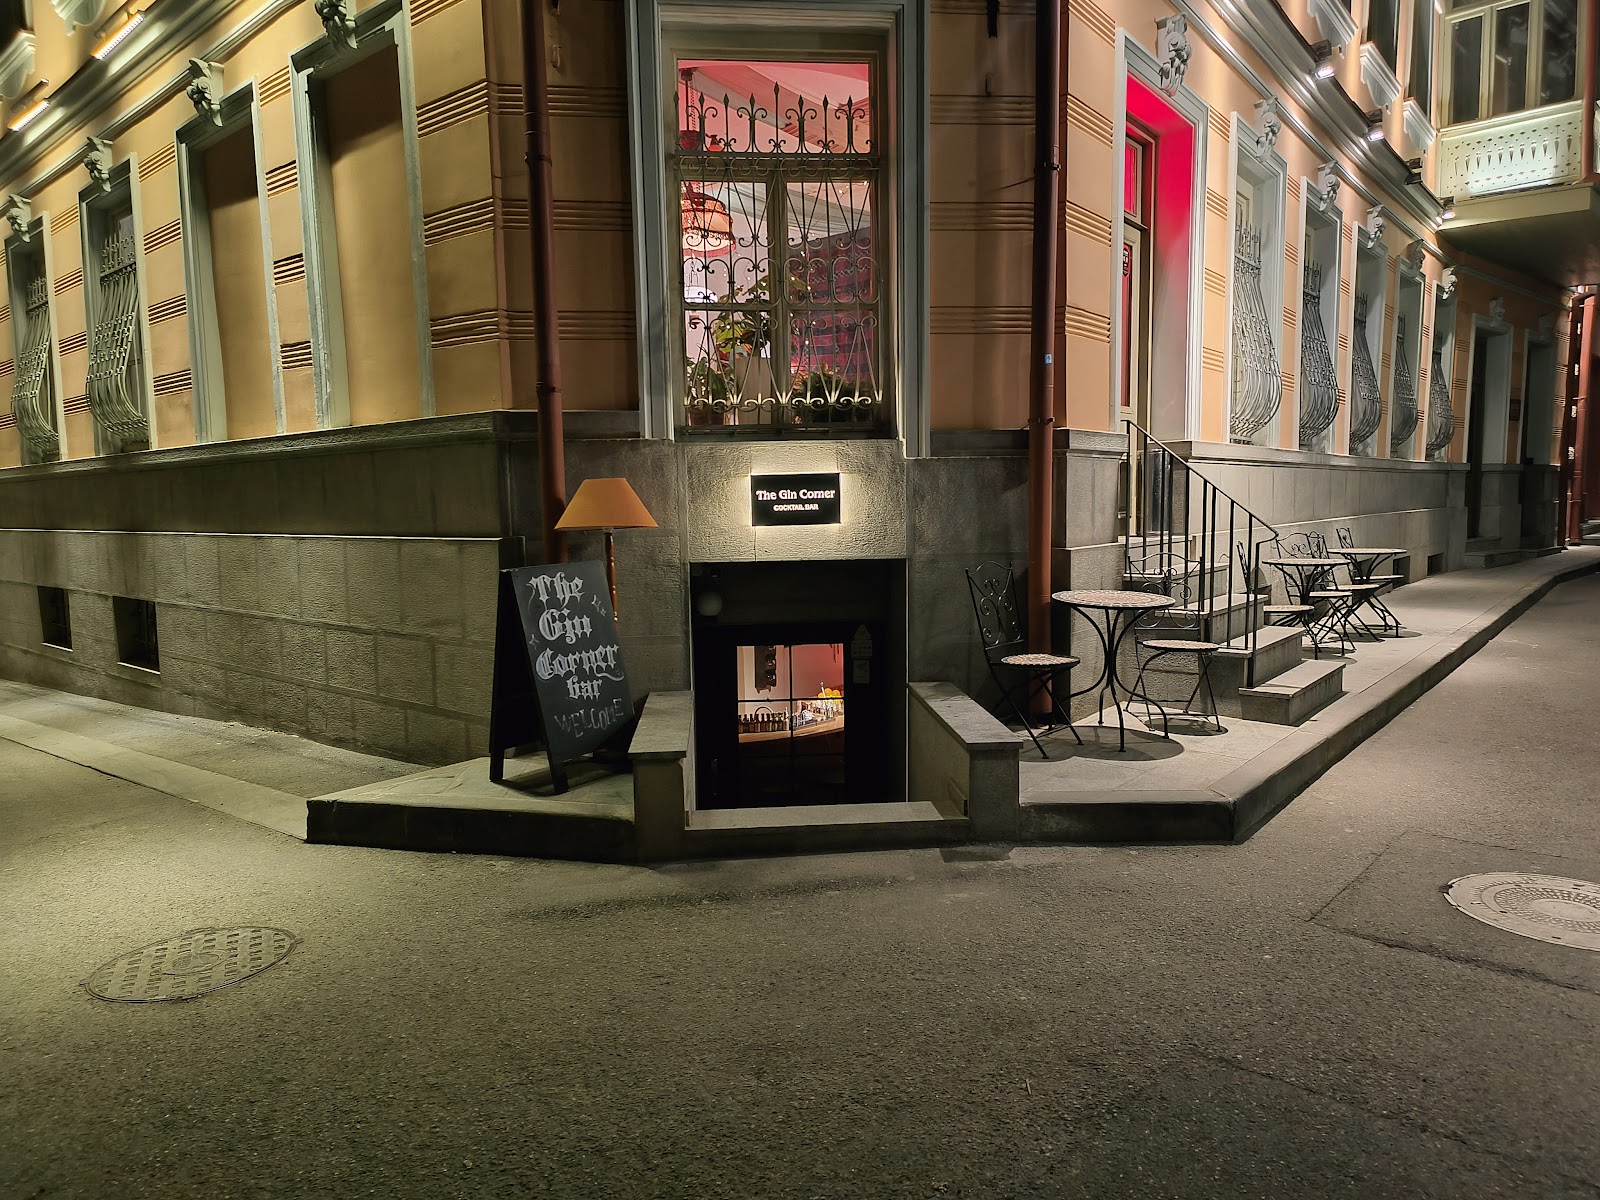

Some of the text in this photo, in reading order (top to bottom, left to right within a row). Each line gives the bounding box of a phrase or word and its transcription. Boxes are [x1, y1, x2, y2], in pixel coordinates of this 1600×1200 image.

[756, 488, 835, 501] The Gin Corner
[773, 503, 819, 512] COCKTAIL BAR
[527, 571, 585, 611] The
[538, 608, 593, 644] Gin
[535, 644, 625, 682] Corner
[554, 698, 624, 738] WELCOME
